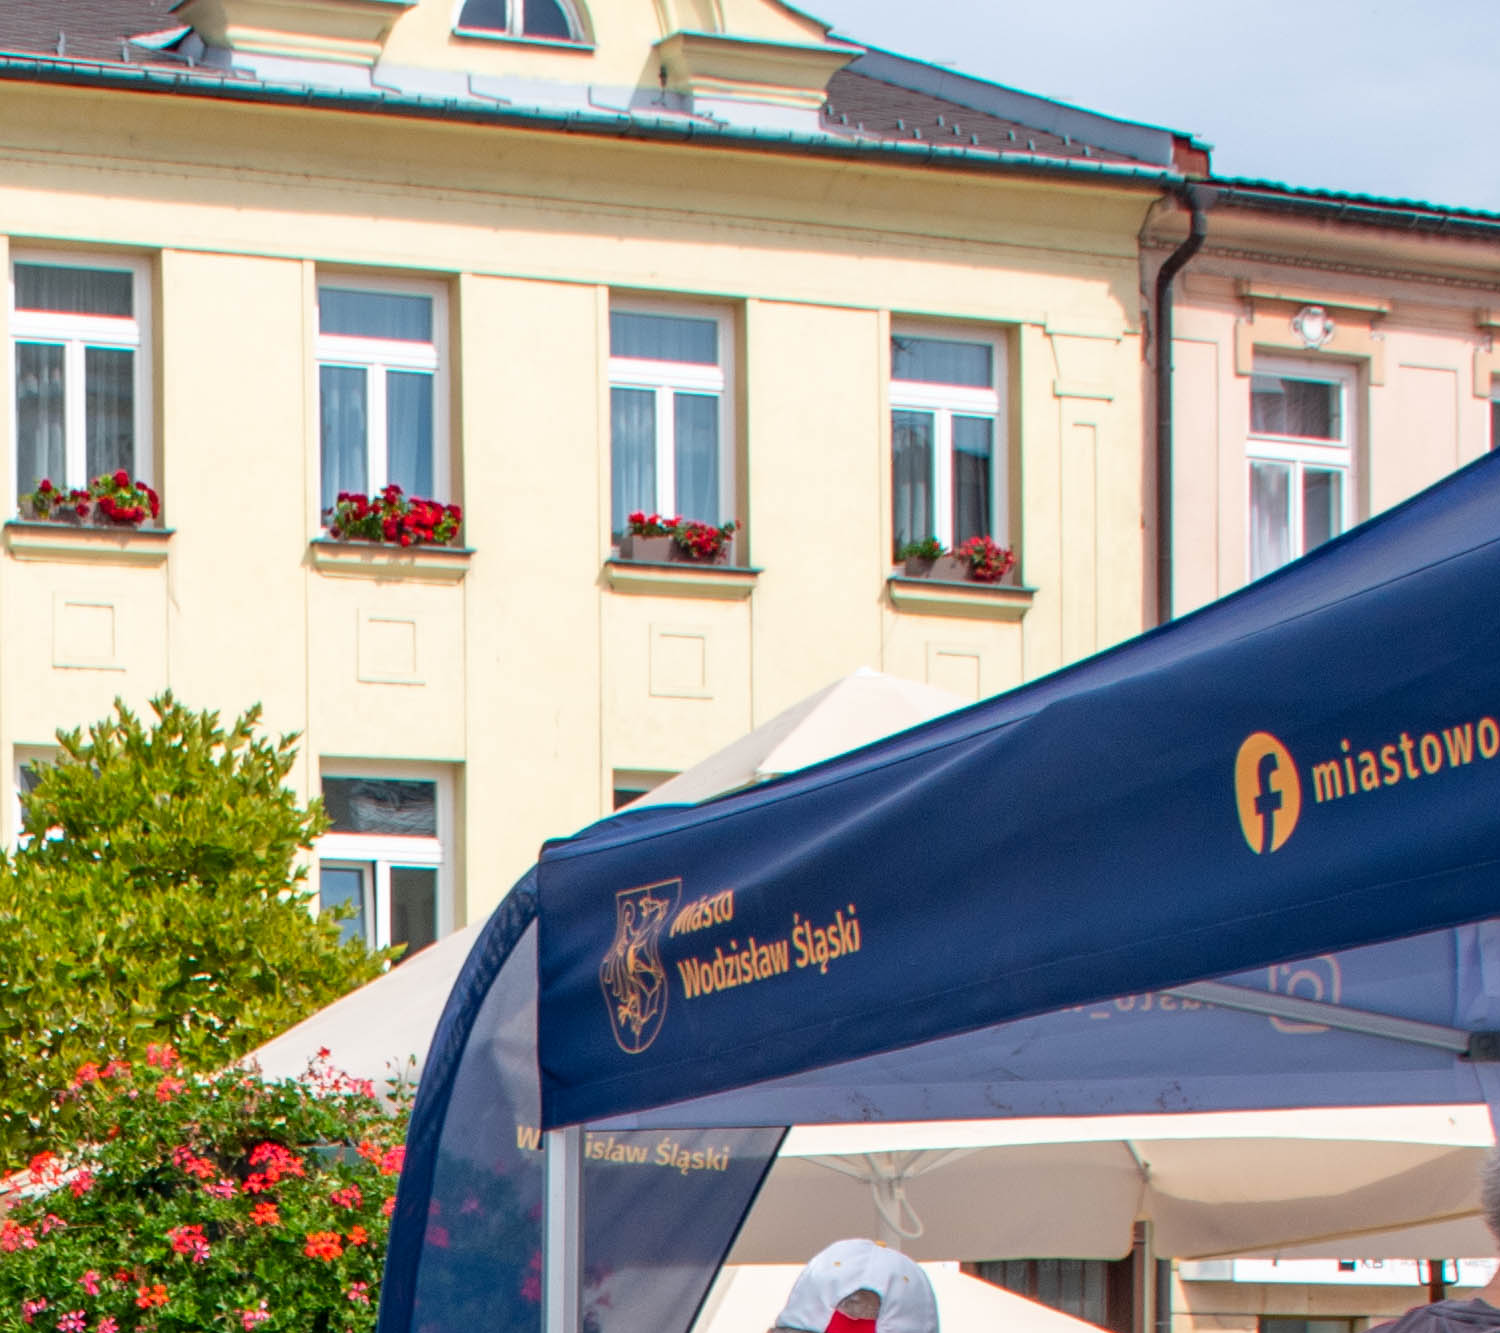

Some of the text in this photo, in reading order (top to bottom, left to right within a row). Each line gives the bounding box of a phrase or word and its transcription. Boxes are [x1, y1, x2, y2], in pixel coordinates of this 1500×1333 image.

[676, 903, 862, 1000] Wodzisław Śląski
[516, 1125, 730, 1177] Wisław Śląski
